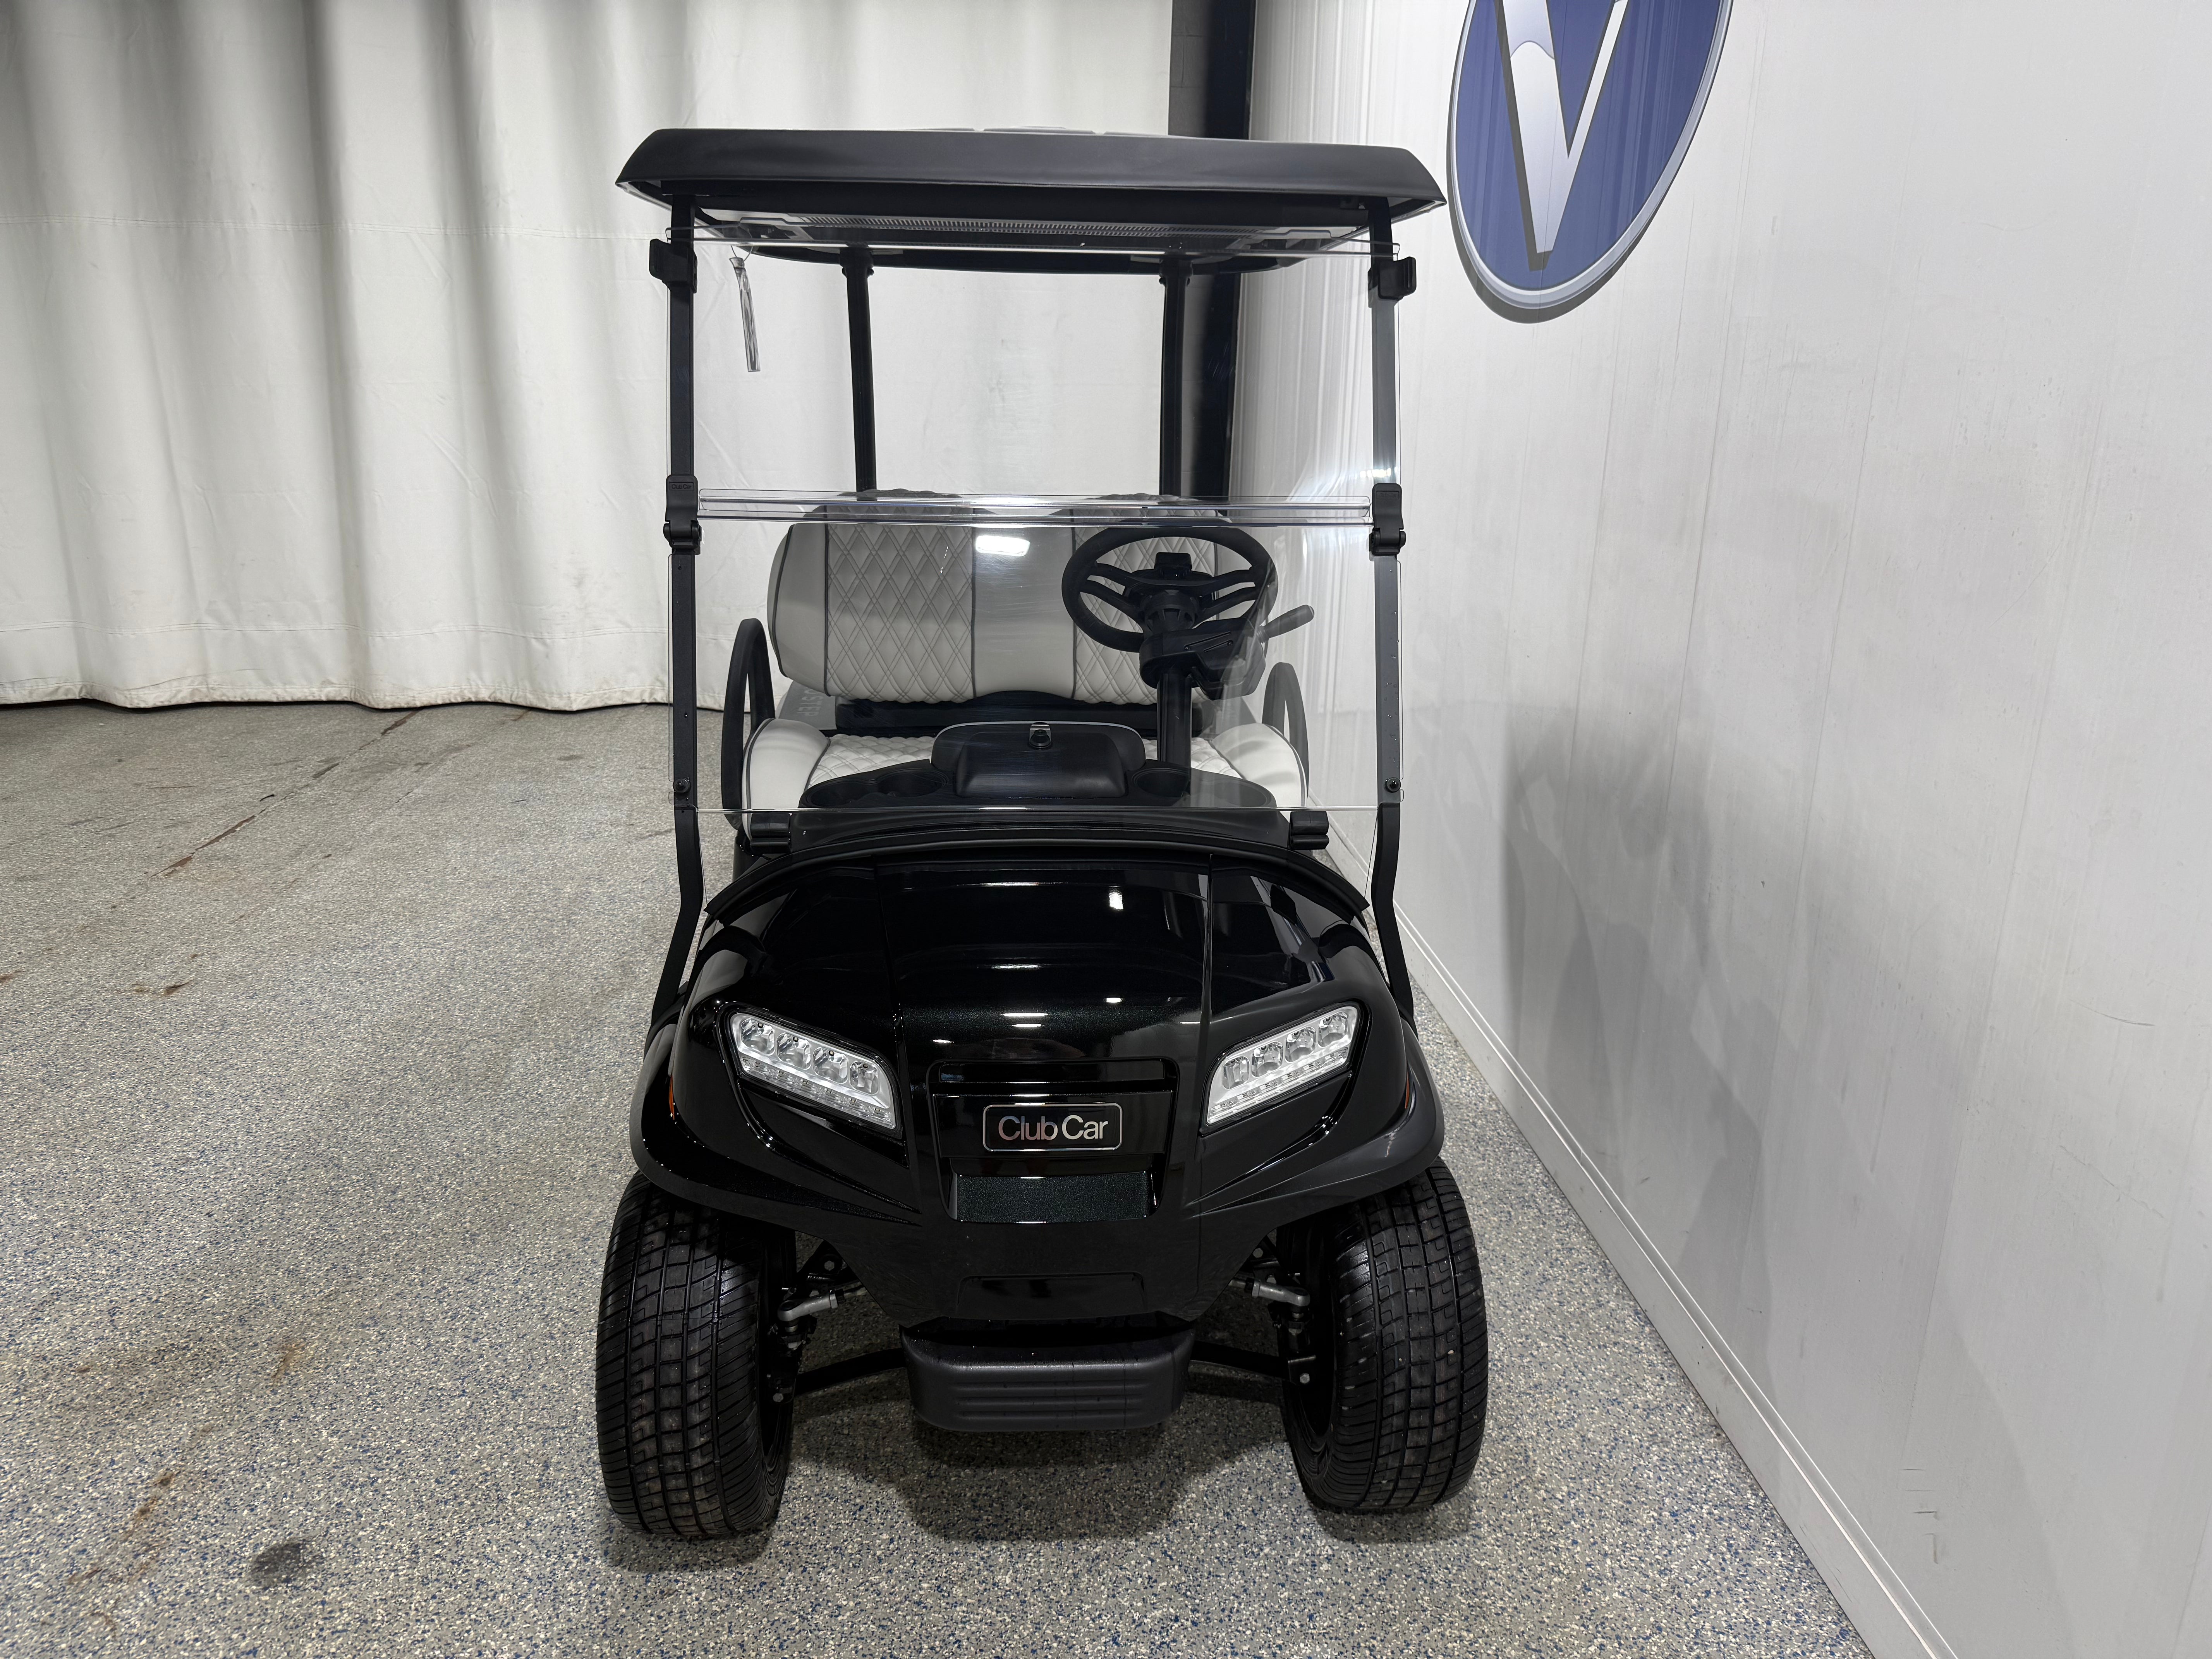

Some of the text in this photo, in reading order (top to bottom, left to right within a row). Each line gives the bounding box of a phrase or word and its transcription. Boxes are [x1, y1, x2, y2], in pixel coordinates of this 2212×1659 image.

[1502, 0, 1627, 254] V
[797, 696, 824, 716] STEP
[998, 1115, 1108, 1140] Club Car
